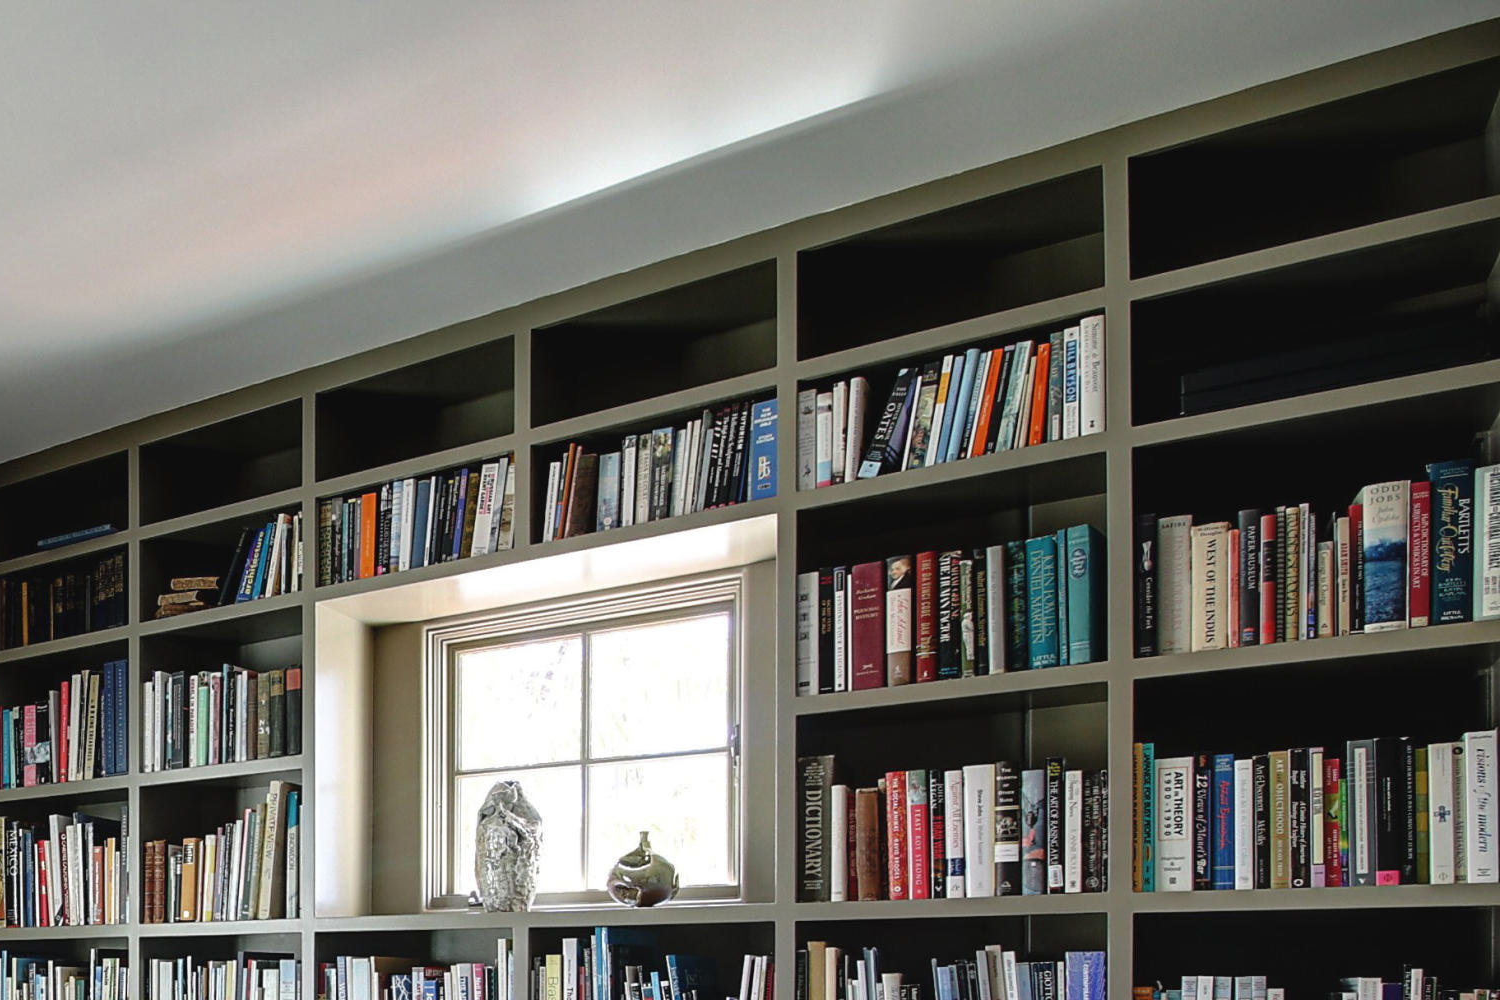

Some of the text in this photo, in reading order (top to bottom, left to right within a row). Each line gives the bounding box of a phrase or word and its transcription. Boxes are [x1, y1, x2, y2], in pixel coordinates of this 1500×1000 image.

[1066, 341, 1077, 361] BILL
[1066, 363, 1077, 402] BRYSON
[737, 411, 748, 450] FUTURISM
[874, 402, 896, 441] OATES
[1370, 484, 1400, 495] ODD
[1247, 525, 1256, 590] PAPER MUSEUM
[1030, 549, 1043, 644] DANIEL MARTIN
[1205, 539, 1217, 643] WEST OF THE INDUS
[921, 601, 932, 619] CODE
[1049, 780, 1059, 795] THE
[1173, 771, 1183, 790] ART
[1196, 773, 1208, 788] 12
[1049, 795, 1059, 810] ART
[1143, 786, 1151, 801] FOR
[1049, 810, 1059, 820] OF
[1173, 797, 1183, 836] THEORY
[804, 789, 823, 877] DICTIONARY
[1049, 820, 1059, 848] RAISING
[9, 829, 18, 877] MEXICO
[1196, 858, 1207, 874] Bar
